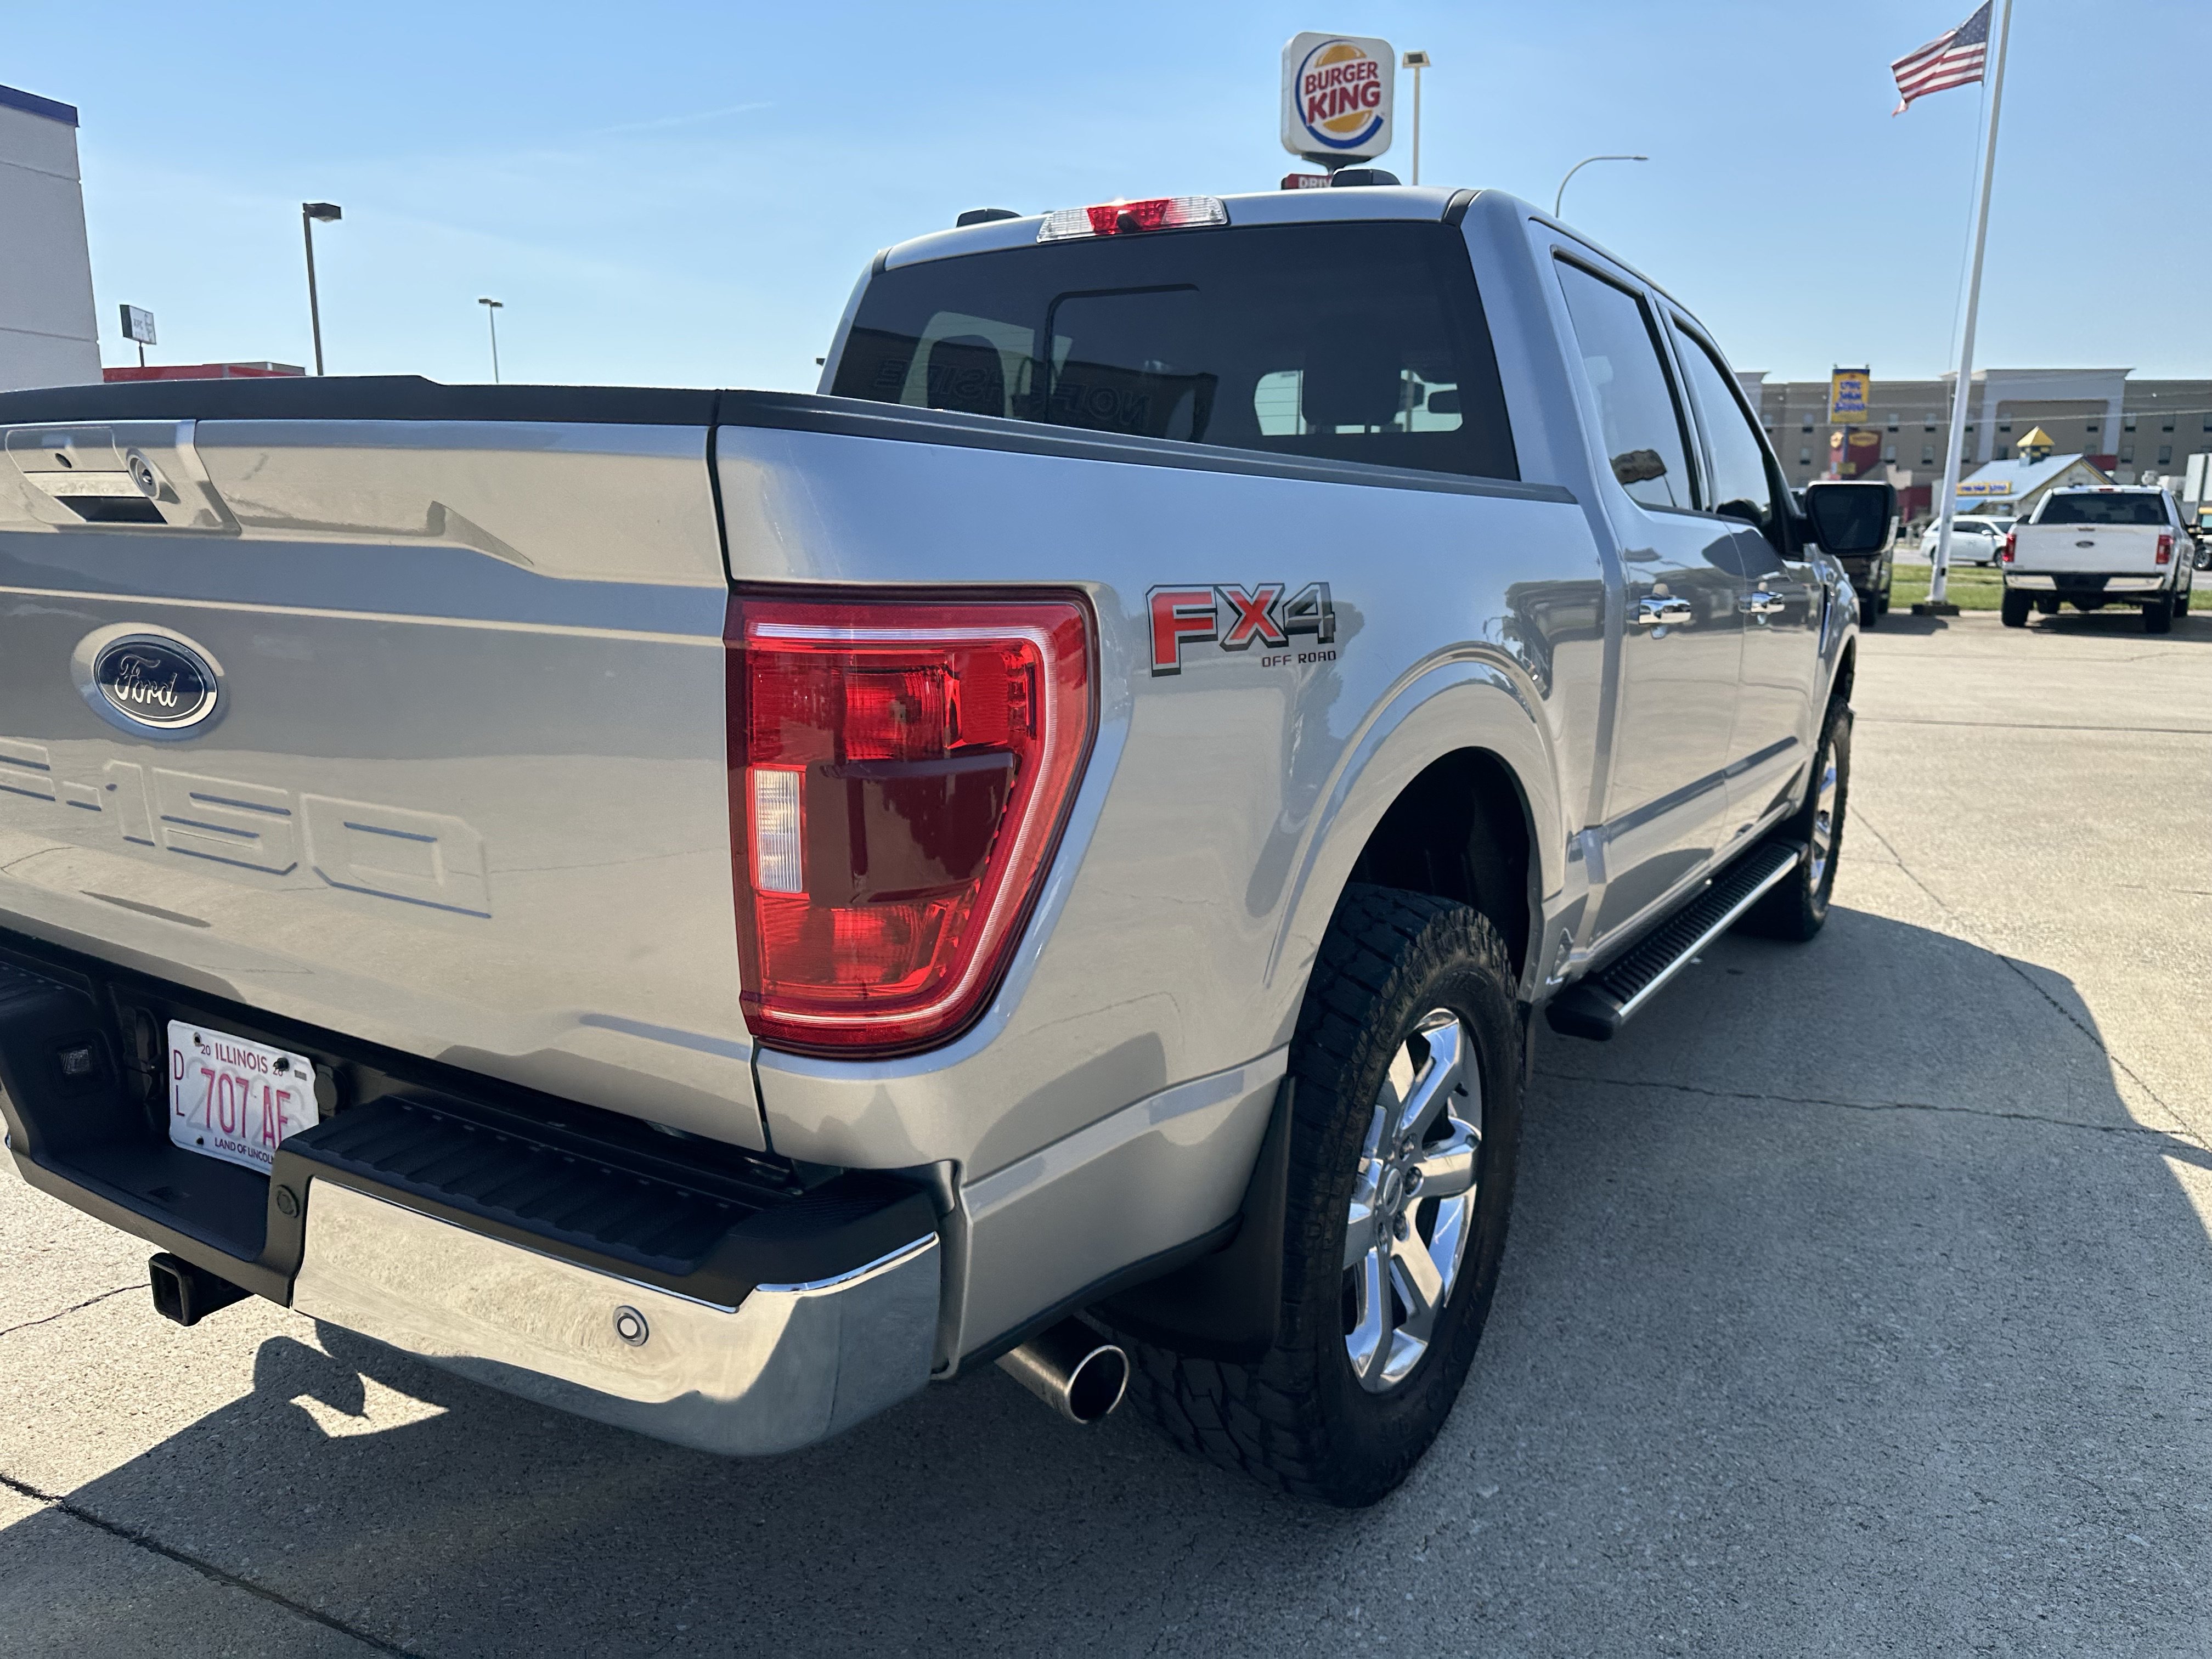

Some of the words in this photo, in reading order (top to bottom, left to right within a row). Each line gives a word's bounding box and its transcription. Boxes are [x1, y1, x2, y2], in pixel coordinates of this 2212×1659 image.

[1304, 61, 1379, 97] BURGER
[1306, 81, 1381, 125] KING
[1146, 582, 1336, 678] FX4
[1262, 654, 1291, 668] OFF
[1298, 651, 1336, 664] ROAD
[114, 654, 178, 708] Ford
[201, 1044, 211, 1056] 20
[216, 1042, 268, 1074] ILLINOIS
[201, 1067, 250, 1139] 707
[215, 1137, 236, 1152] LAND
[237, 1143, 247, 1154] OF
